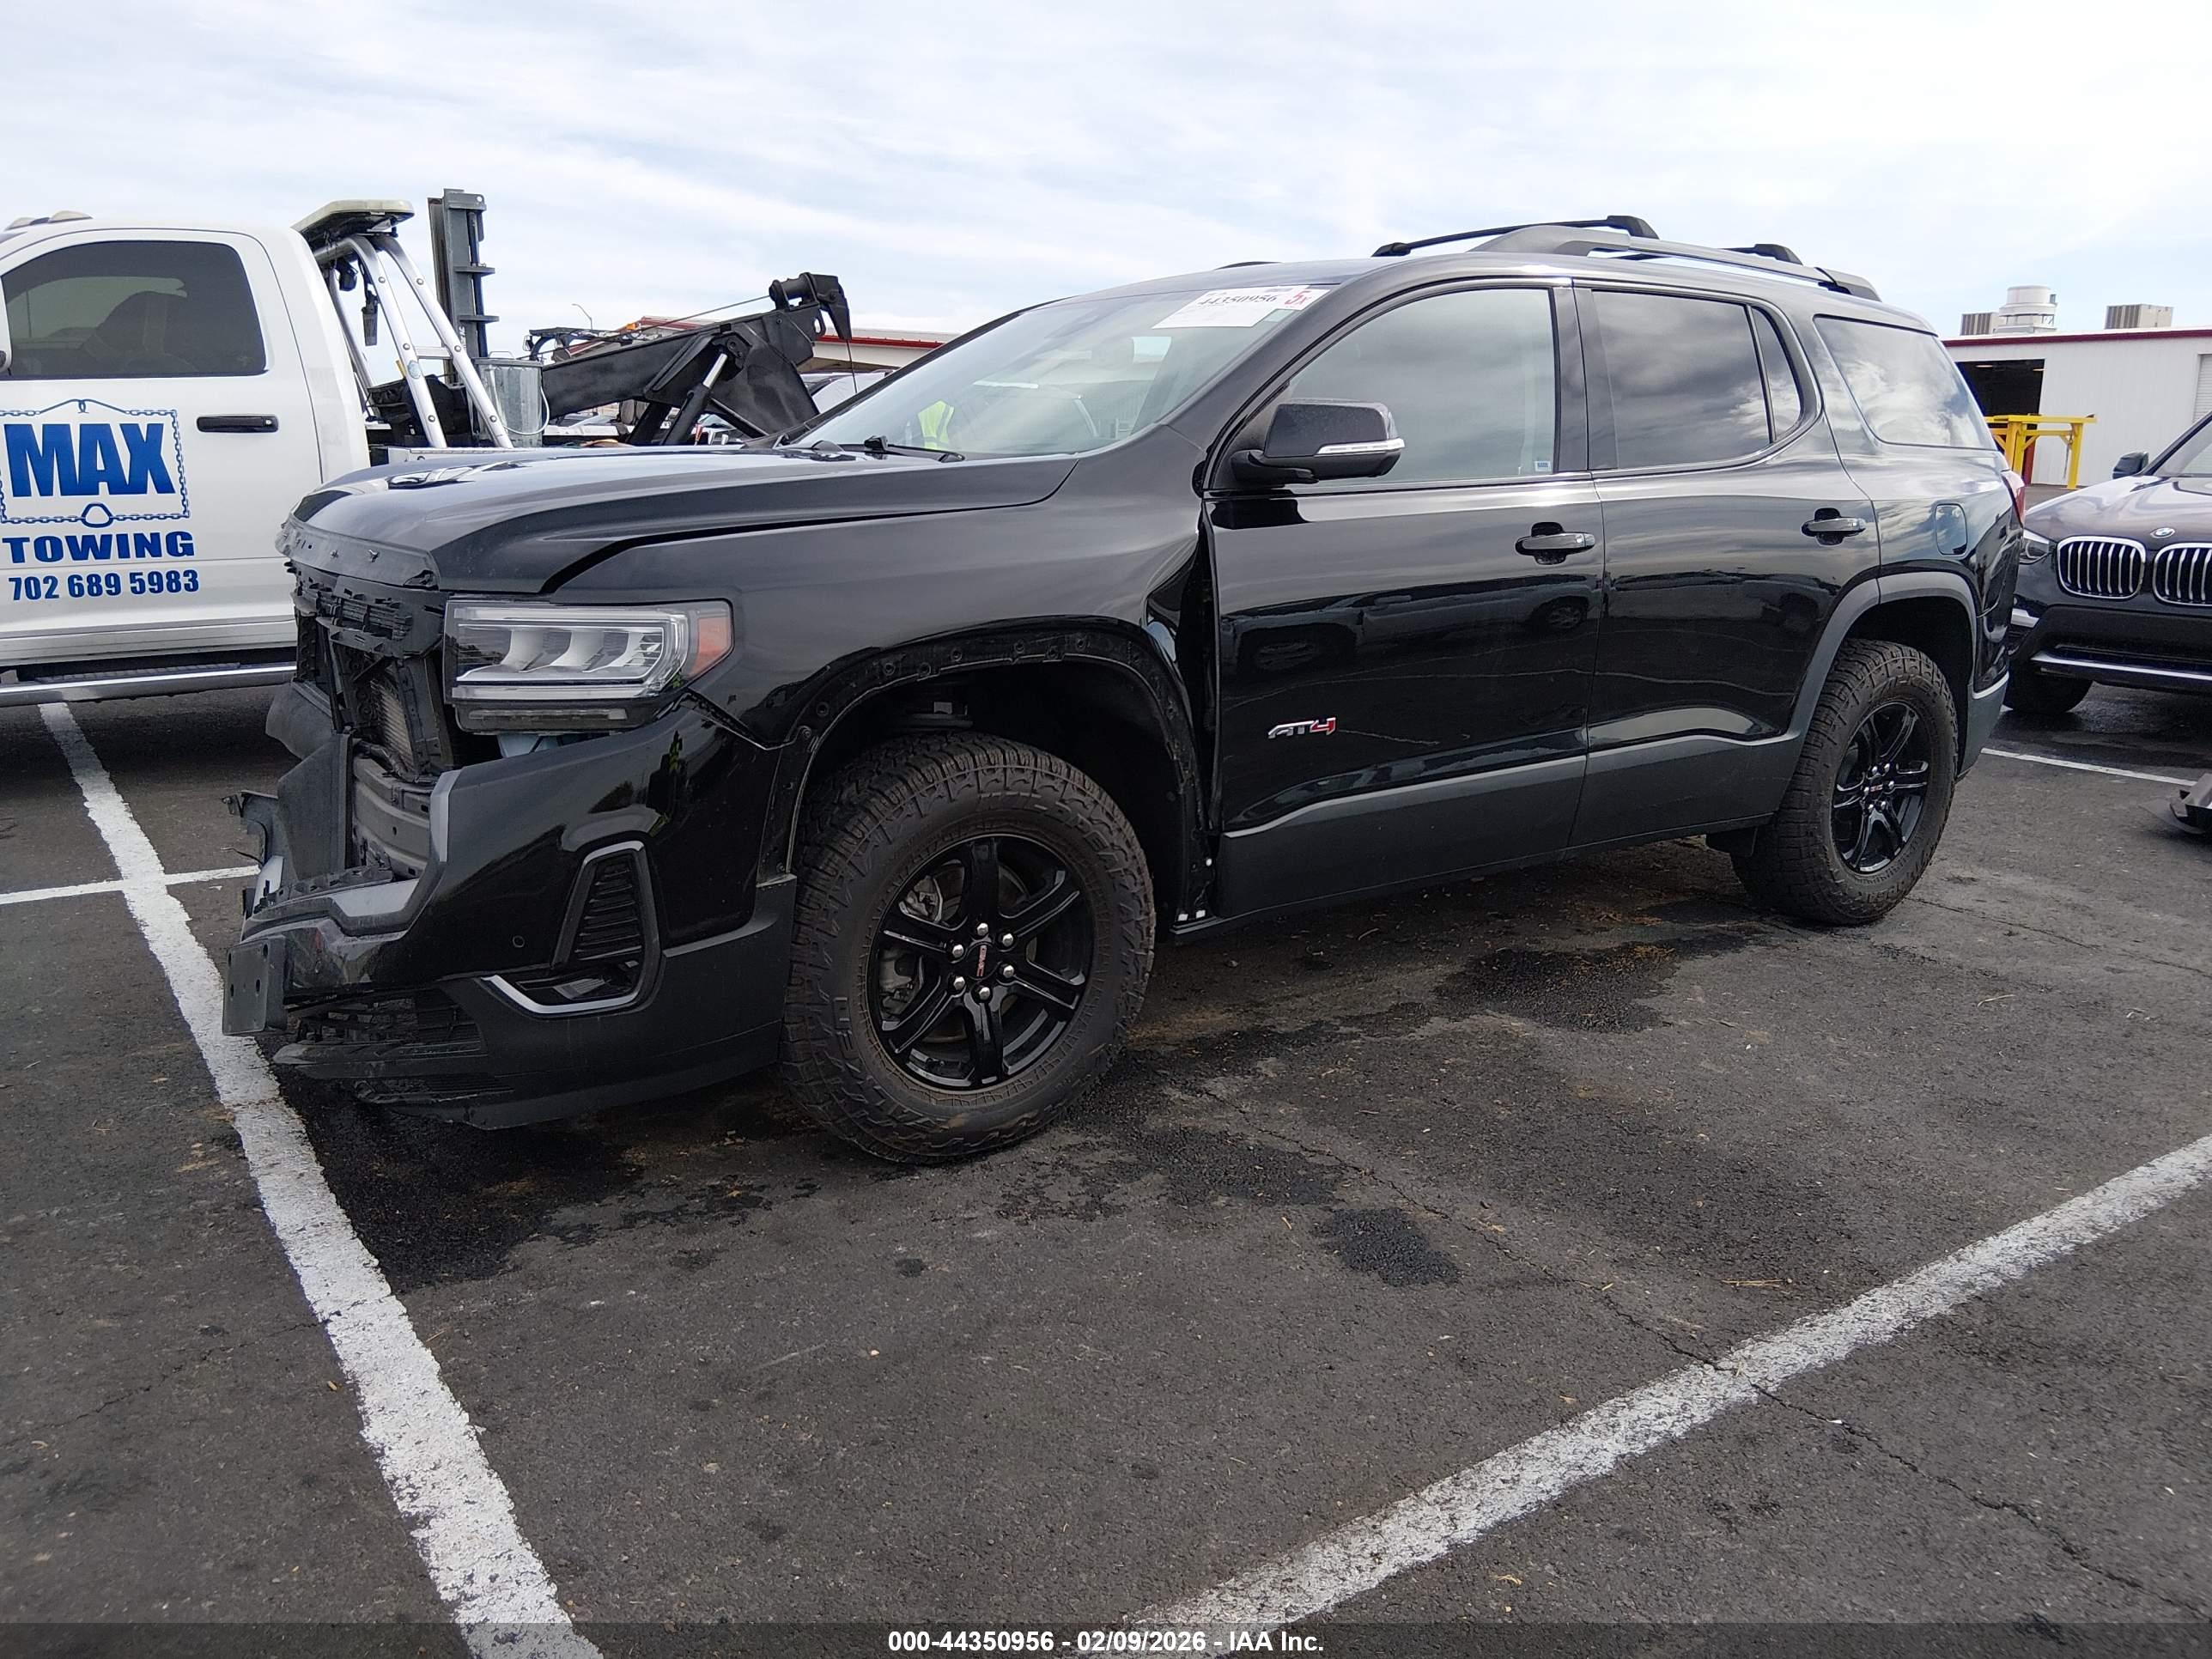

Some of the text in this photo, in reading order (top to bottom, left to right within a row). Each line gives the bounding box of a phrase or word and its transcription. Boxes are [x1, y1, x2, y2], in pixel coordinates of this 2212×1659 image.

[1196, 295, 1278, 306] 44350956
[4, 423, 176, 497] MAX
[2, 531, 195, 563] TOWING
[9, 569, 199, 601] 702 689 5983
